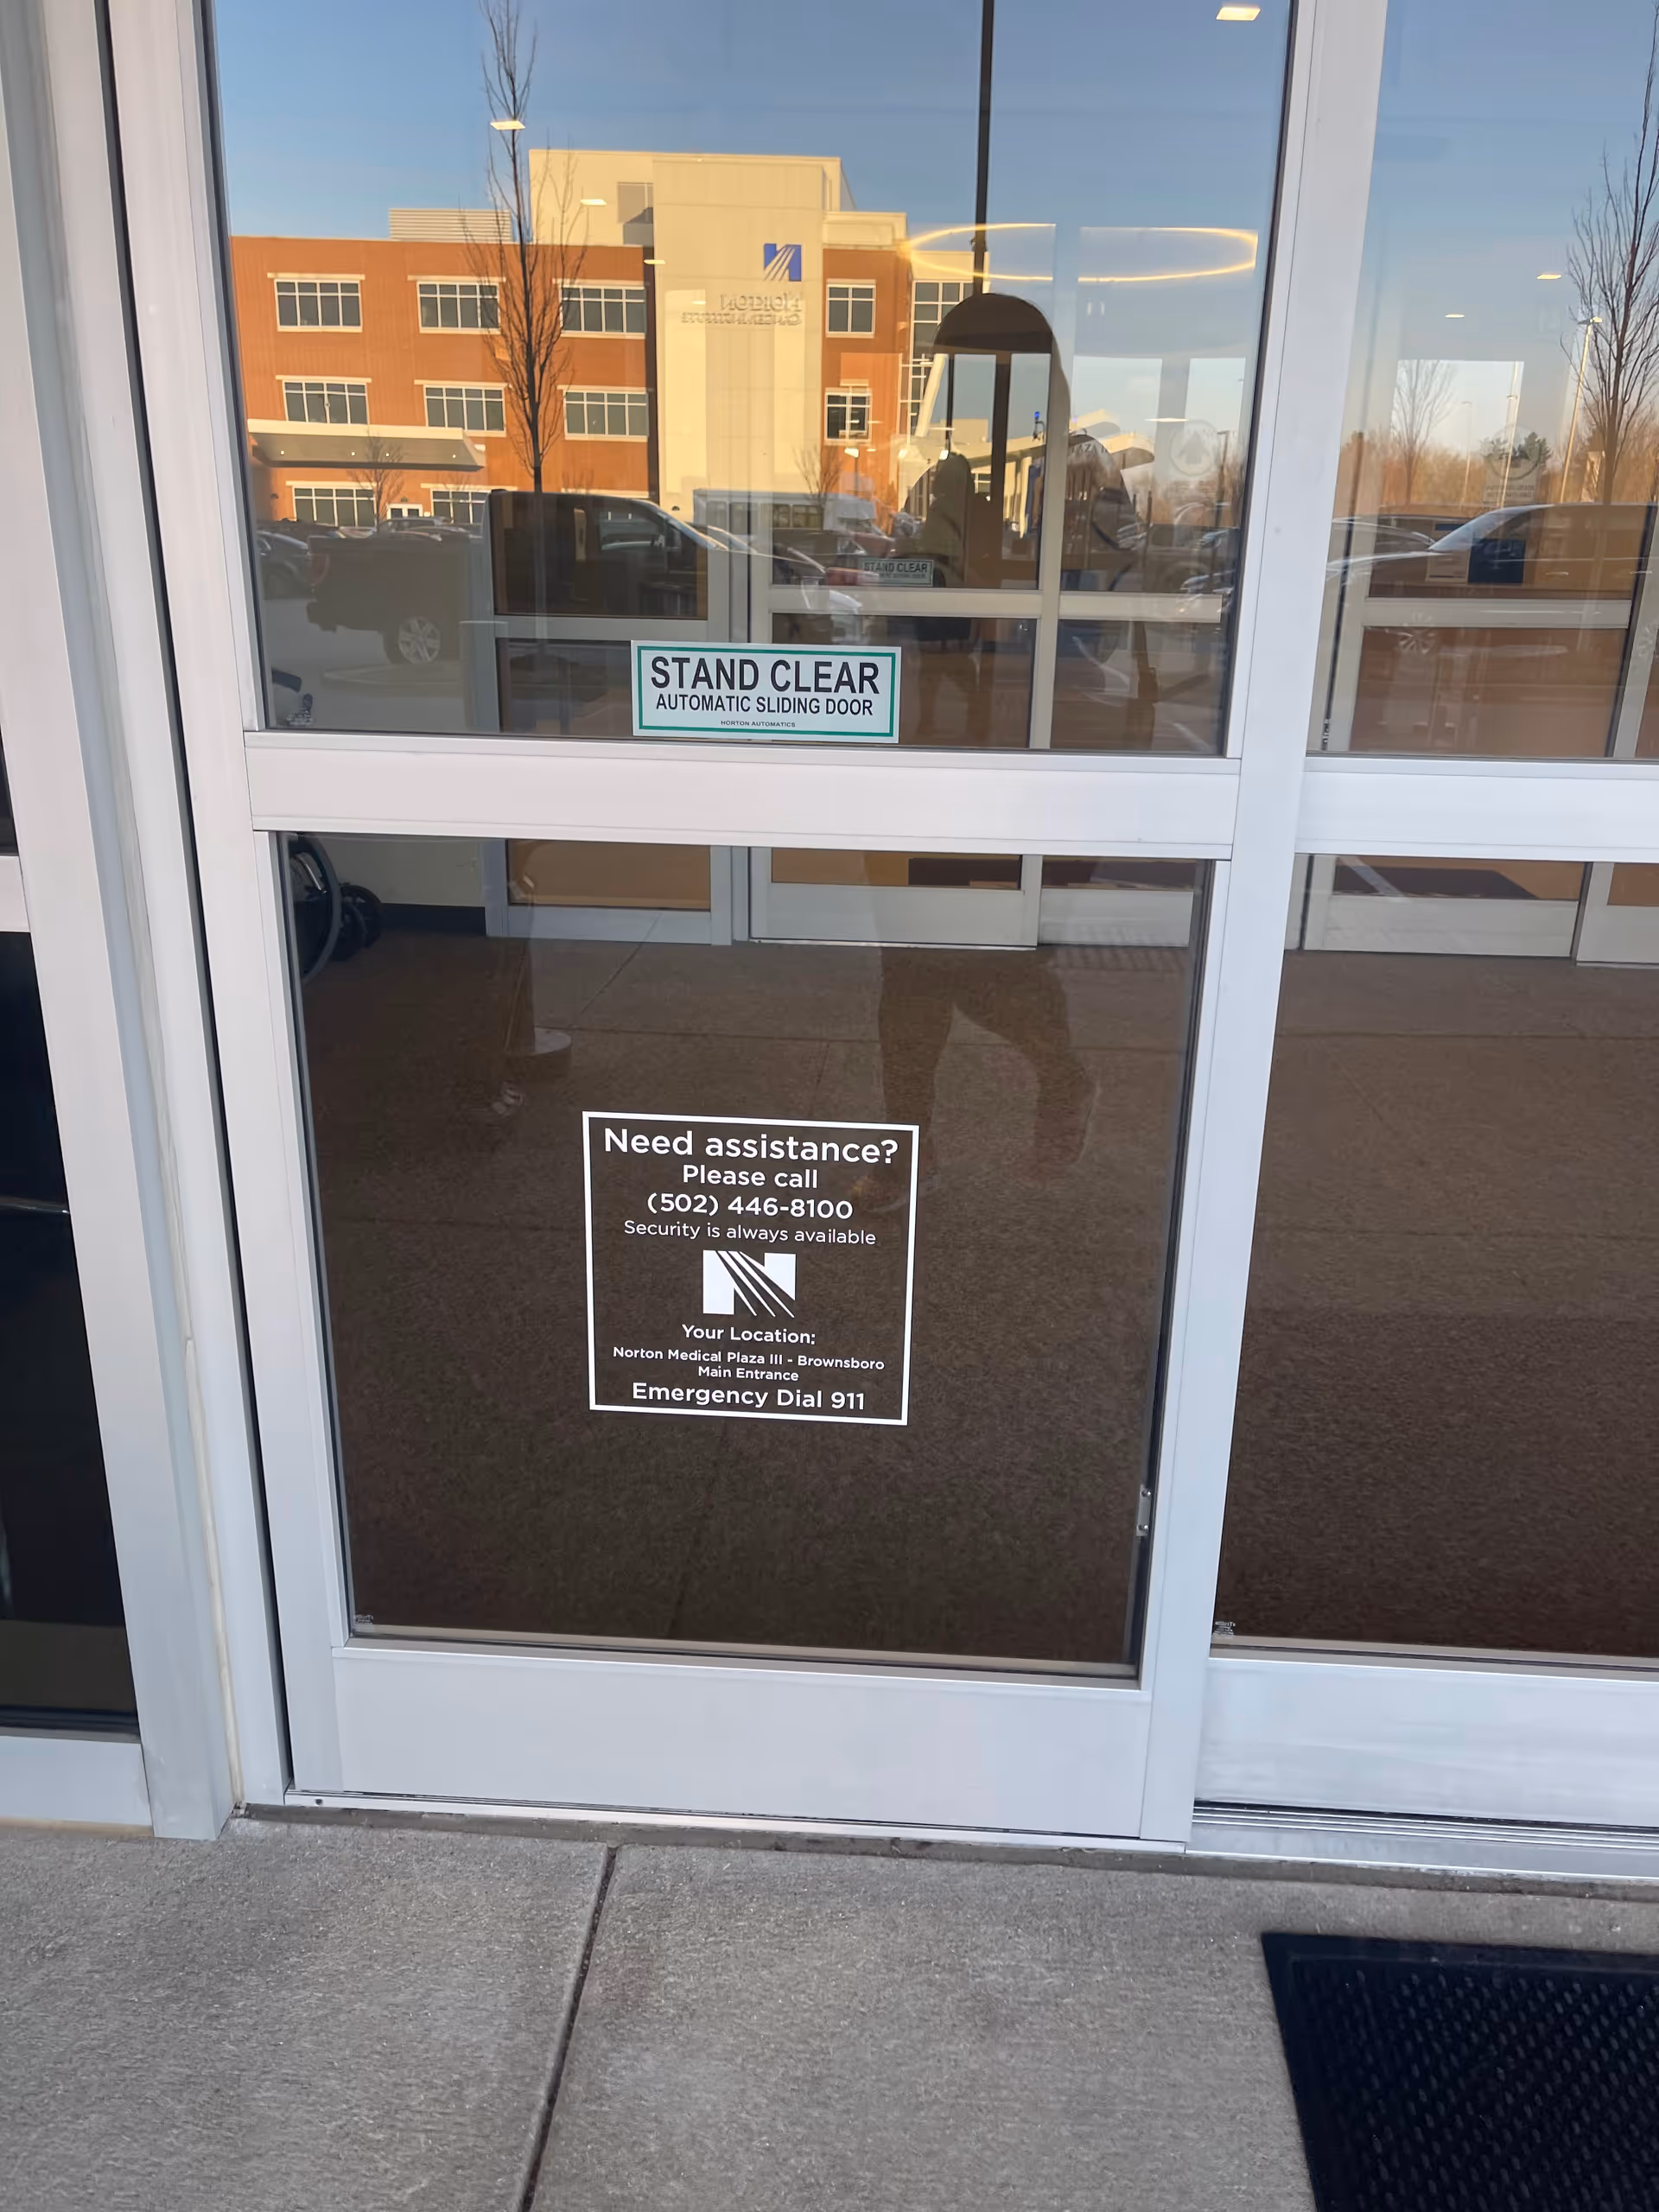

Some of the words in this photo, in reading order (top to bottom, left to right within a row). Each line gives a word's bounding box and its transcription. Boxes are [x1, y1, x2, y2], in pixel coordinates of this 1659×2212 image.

[864, 562, 894, 573] STAND
[897, 563, 927, 573] CLEAR
[651, 656, 760, 691] STAND
[770, 659, 880, 695] CLEAR
[656, 693, 751, 713] AUTOMATIC
[756, 696, 820, 715] SLIDING
[825, 698, 874, 716] DOOR
[604, 1128, 693, 1156] Need
[705, 1133, 899, 1164] assistance?
[683, 1164, 766, 1186] Please
[774, 1168, 817, 1189] call
[647, 1192, 719, 1217] (502)
[728, 1197, 853, 1219] 446-8100
[624, 1219, 701, 1238] Security
[707, 1222, 721, 1238] is
[726, 1224, 789, 1243] always
[794, 1228, 876, 1245] available
[682, 1324, 725, 1340] Your
[730, 1327, 817, 1345] Location:
[613, 1346, 664, 1360] Norton
[668, 1349, 722, 1363] Medical
[727, 1351, 766, 1365] Plaza
[769, 1353, 783, 1365] III
[798, 1355, 885, 1370] Brownsboro
[698, 1365, 732, 1378] Main
[736, 1367, 800, 1382] Entrance
[632, 1382, 770, 1407] Emergency
[777, 1389, 823, 1408] Dial
[830, 1391, 865, 1410] 911
